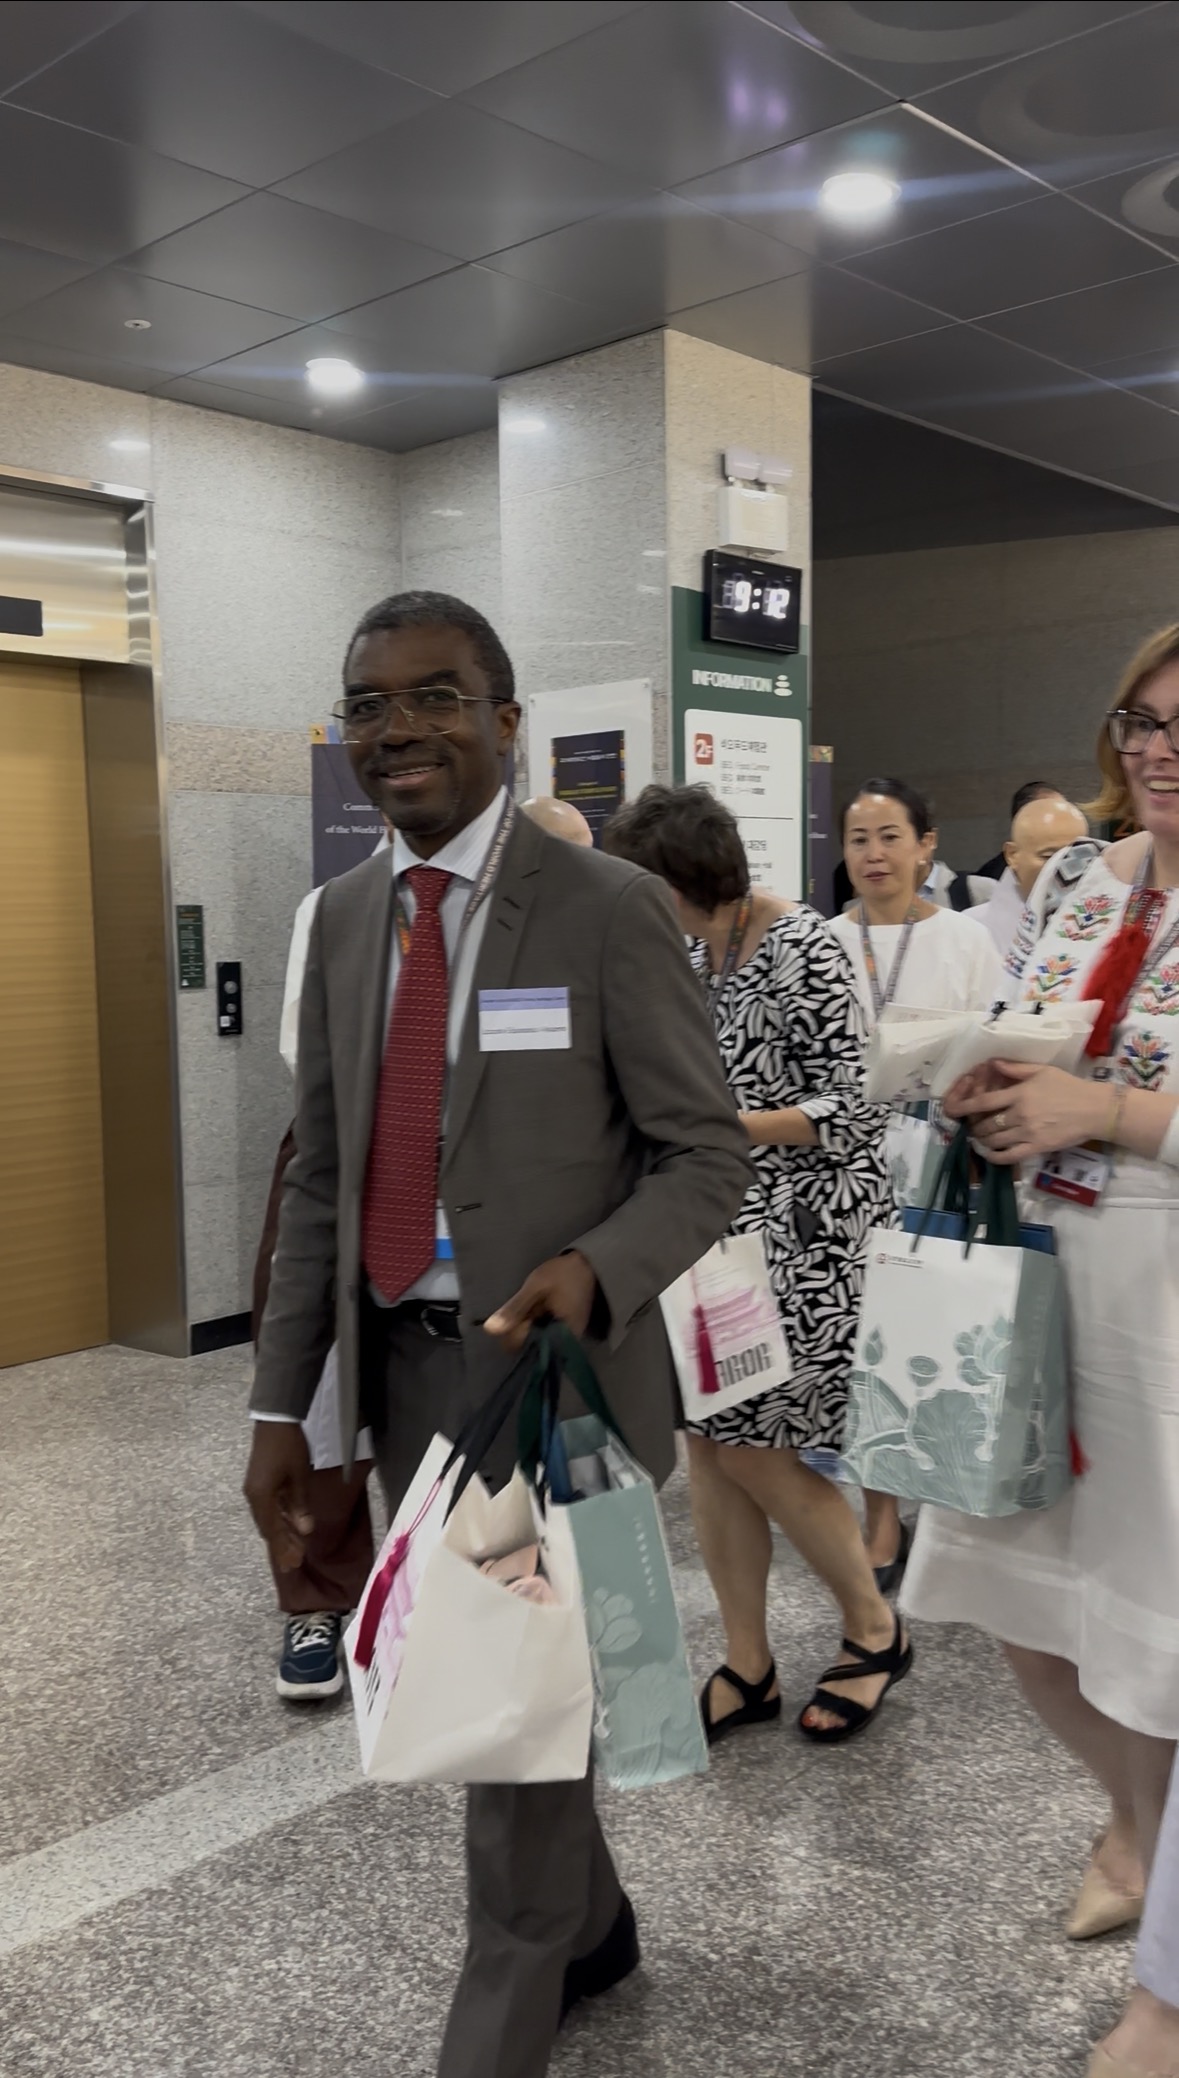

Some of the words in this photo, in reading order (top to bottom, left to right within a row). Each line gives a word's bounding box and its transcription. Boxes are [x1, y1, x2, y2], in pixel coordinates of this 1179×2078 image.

[692, 669, 773, 692] INFORMATION
[696, 739, 713, 758] 2F
[351, 825, 376, 834] World
